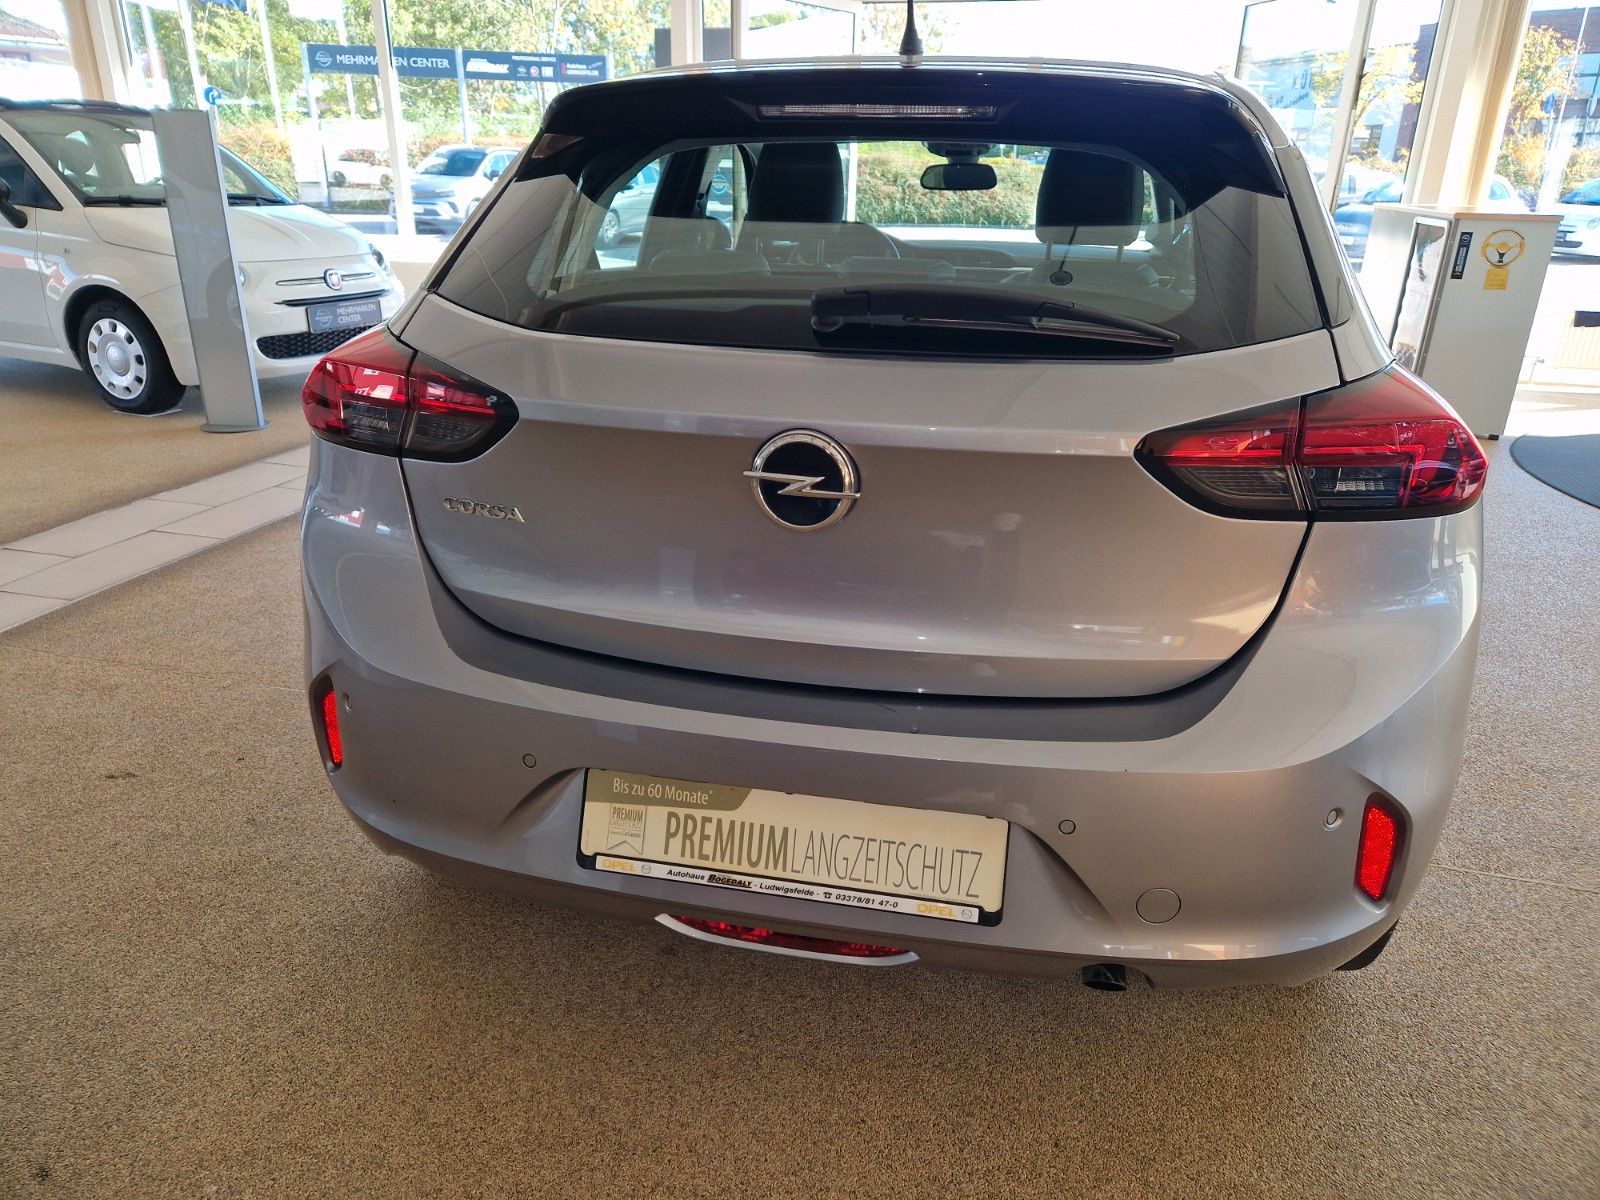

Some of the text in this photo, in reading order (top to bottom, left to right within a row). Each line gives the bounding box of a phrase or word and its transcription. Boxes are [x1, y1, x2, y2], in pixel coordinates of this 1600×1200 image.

[336, 54, 450, 69] MEHRMAEN CENTER
[442, 497, 525, 523] CORSA
[613, 777, 629, 794] Bis
[632, 783, 645, 796] zu
[647, 783, 662, 797] 60
[612, 806, 643, 822] PREMIUM
[601, 860, 637, 872] OPEL
[667, 869, 705, 881] Autohaus
[760, 882, 815, 897] Ludwigsfelde
[835, 893, 875, 905] 03378/81
[878, 899, 899, 909] 47-0
[917, 902, 956, 919] OPEL
